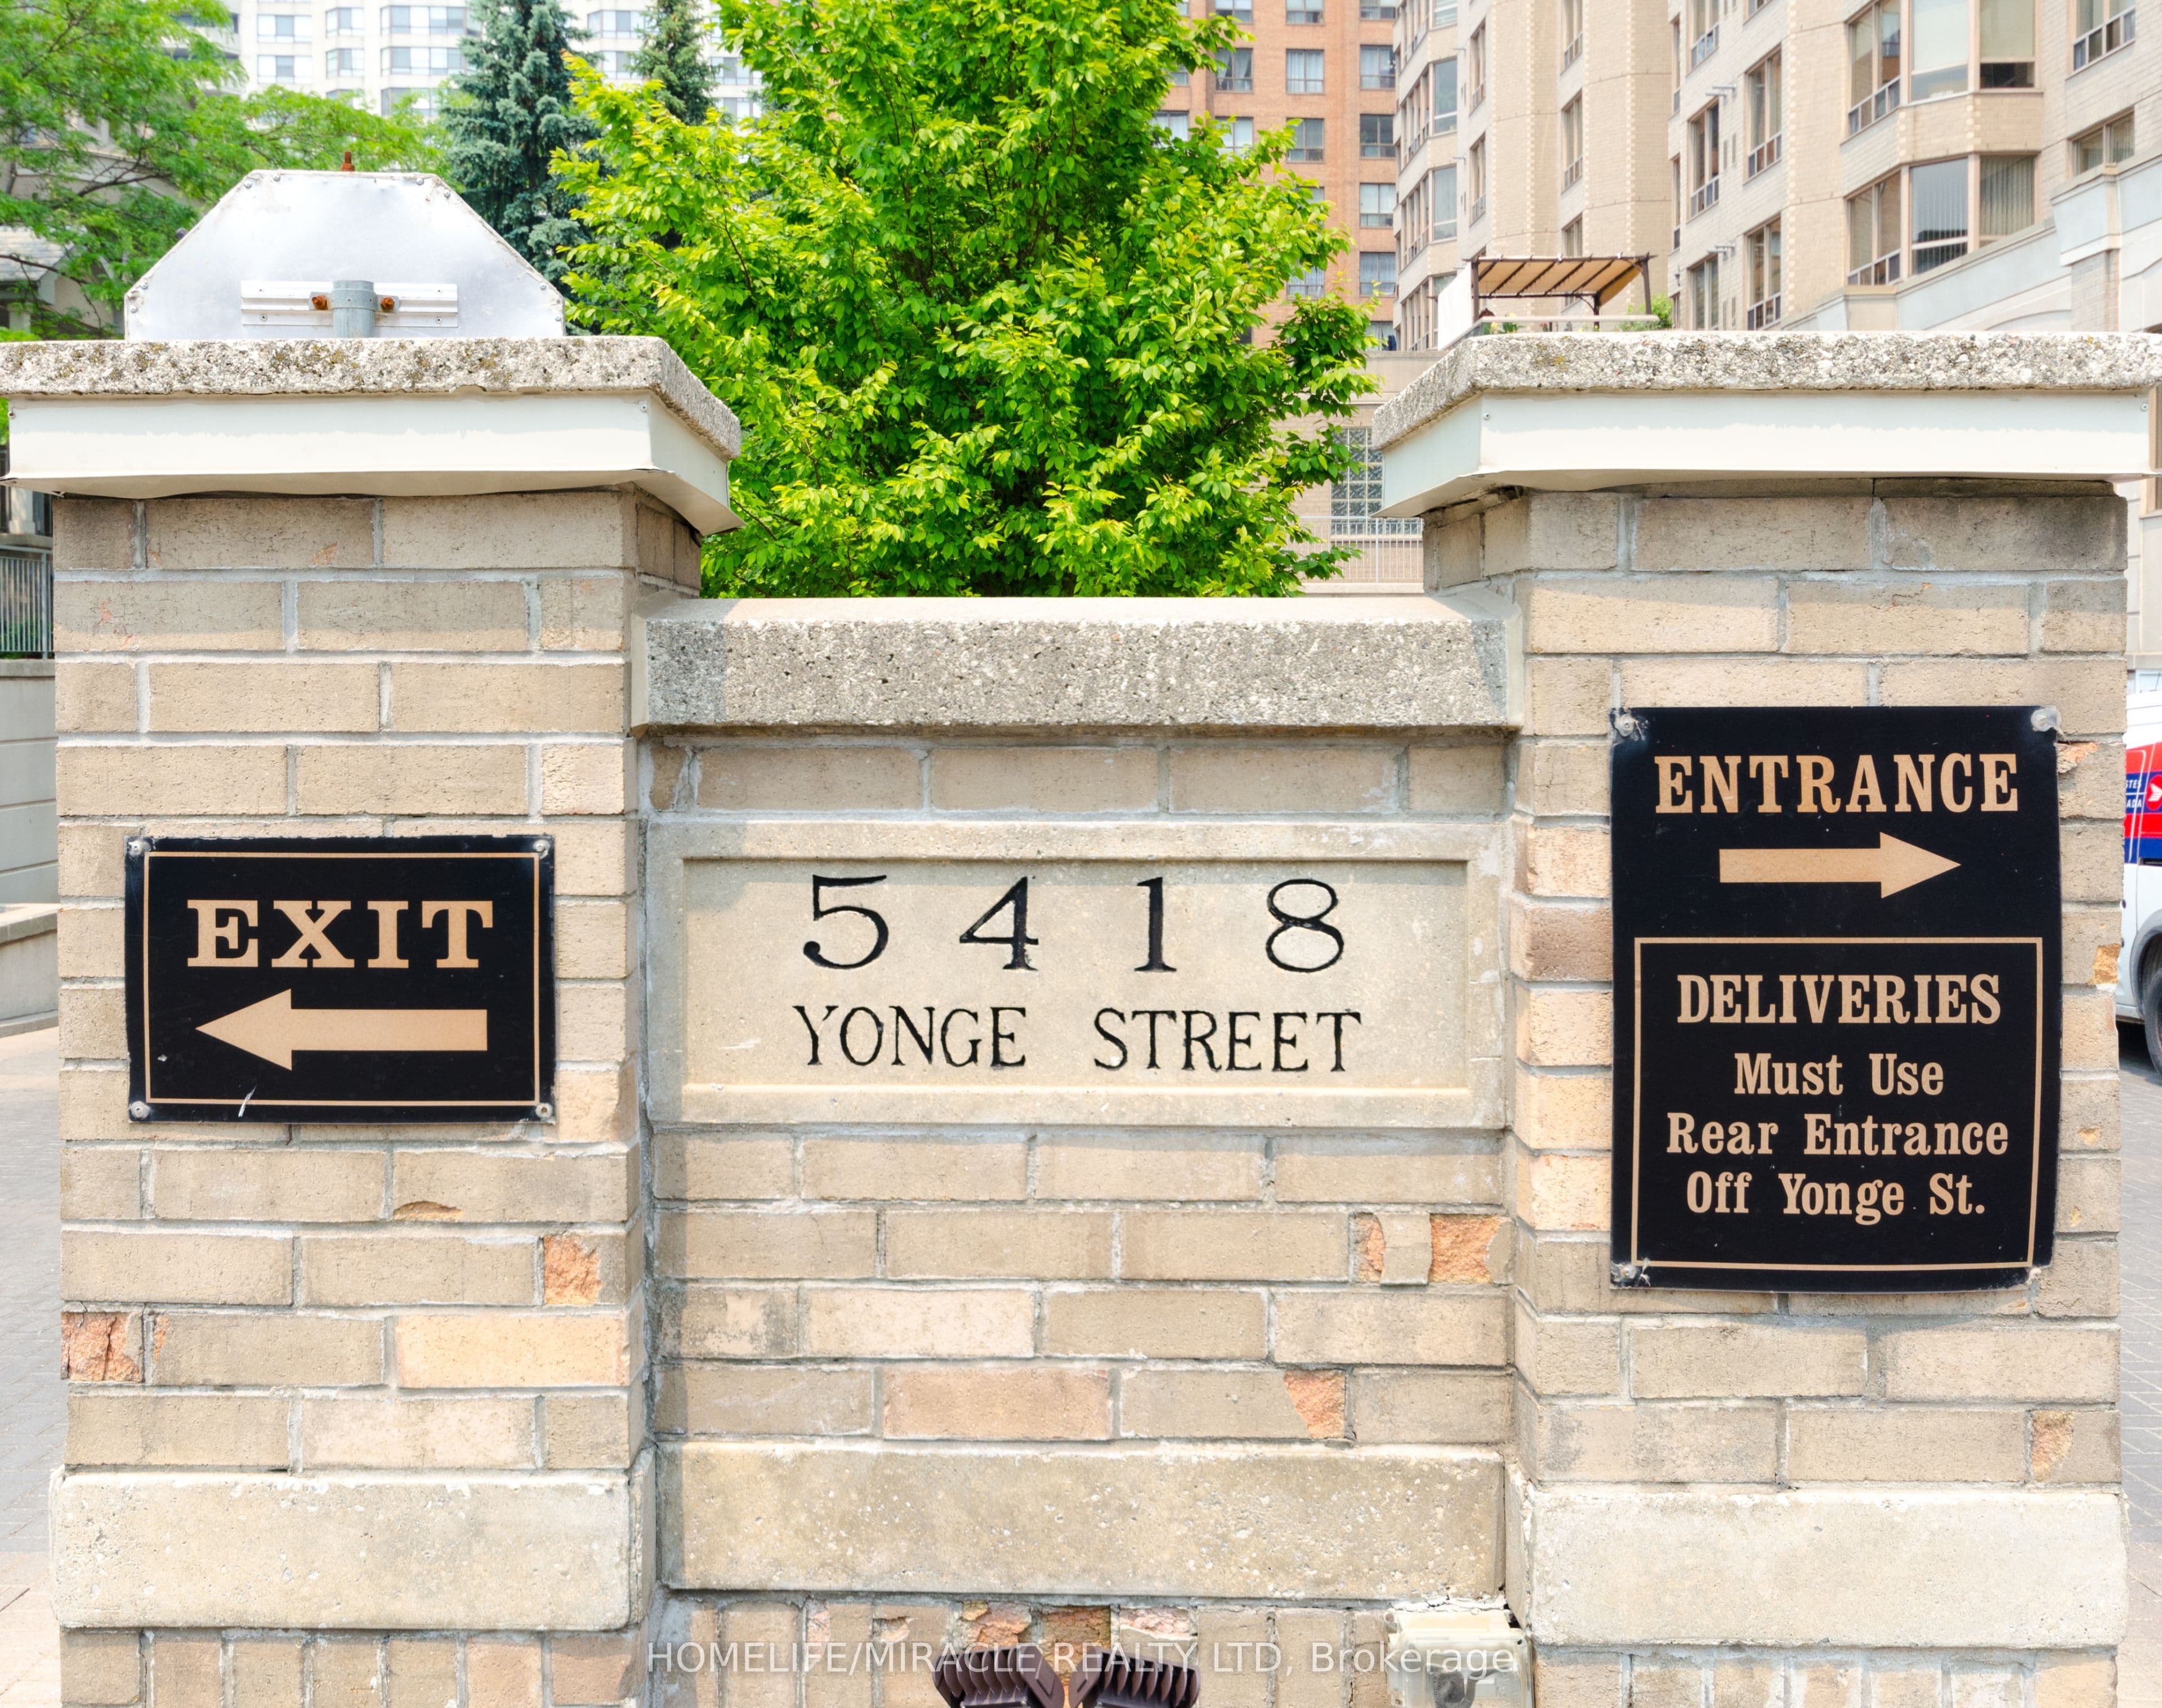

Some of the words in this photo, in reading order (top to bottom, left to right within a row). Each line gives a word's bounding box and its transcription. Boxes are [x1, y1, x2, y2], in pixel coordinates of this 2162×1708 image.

[1654, 753, 2018, 814] ENTRANCE
[187, 900, 493, 968] EXIT
[1677, 974, 2001, 1024] DELIVERIES
[793, 1005, 1026, 1067] YONGE
[1093, 1007, 1362, 1072] STREET
[1734, 1053, 1843, 1095] Must
[1869, 1053, 1944, 1096] Use
[1666, 1112, 1779, 1154] Rear
[1803, 1113, 2008, 1156] Entrance
[1686, 1171, 1752, 1214] Off
[1778, 1173, 1905, 1226] Yonge
[1929, 1173, 1986, 1215] St.
